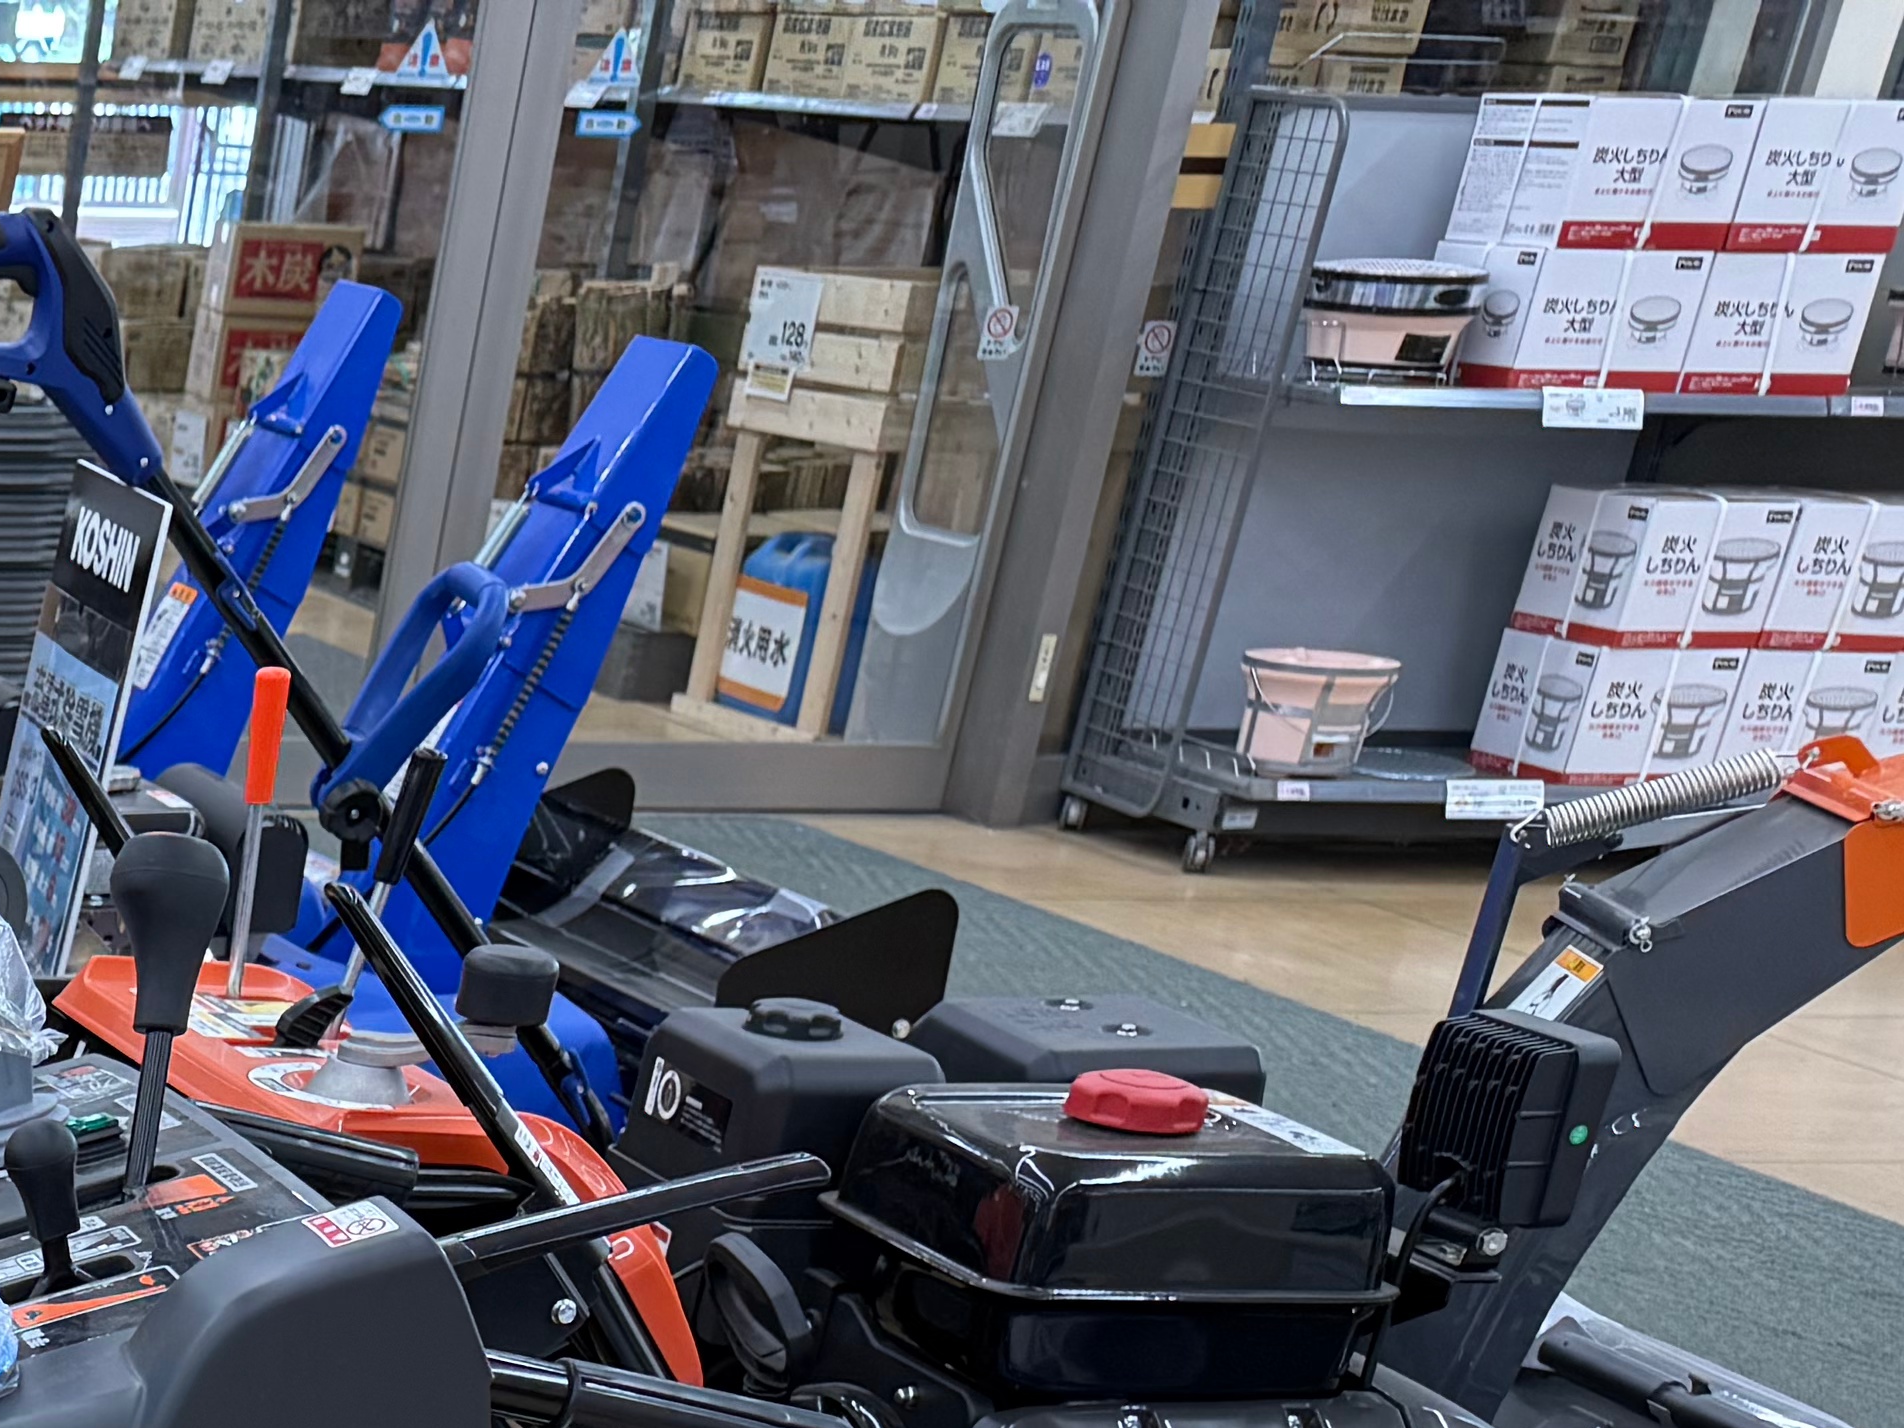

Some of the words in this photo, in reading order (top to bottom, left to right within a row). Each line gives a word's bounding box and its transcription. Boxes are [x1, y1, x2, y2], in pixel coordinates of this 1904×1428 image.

[1613, 167, 1644, 184] 大型
[1786, 169, 1817, 186] 大型
[244, 250, 319, 292] 木炭
[781, 321, 805, 347] 128
[1564, 317, 1595, 334] 大型
[1734, 320, 1765, 336] 大型
[70, 506, 141, 593] KOSHIN
[1661, 535, 1698, 553] 炭火
[1813, 536, 1849, 555] 炭火
[1645, 556, 1700, 575] しちりん
[1797, 556, 1851, 576] しちりん
[1607, 681, 1645, 699] 炭火
[1590, 701, 1647, 719] しちりん
